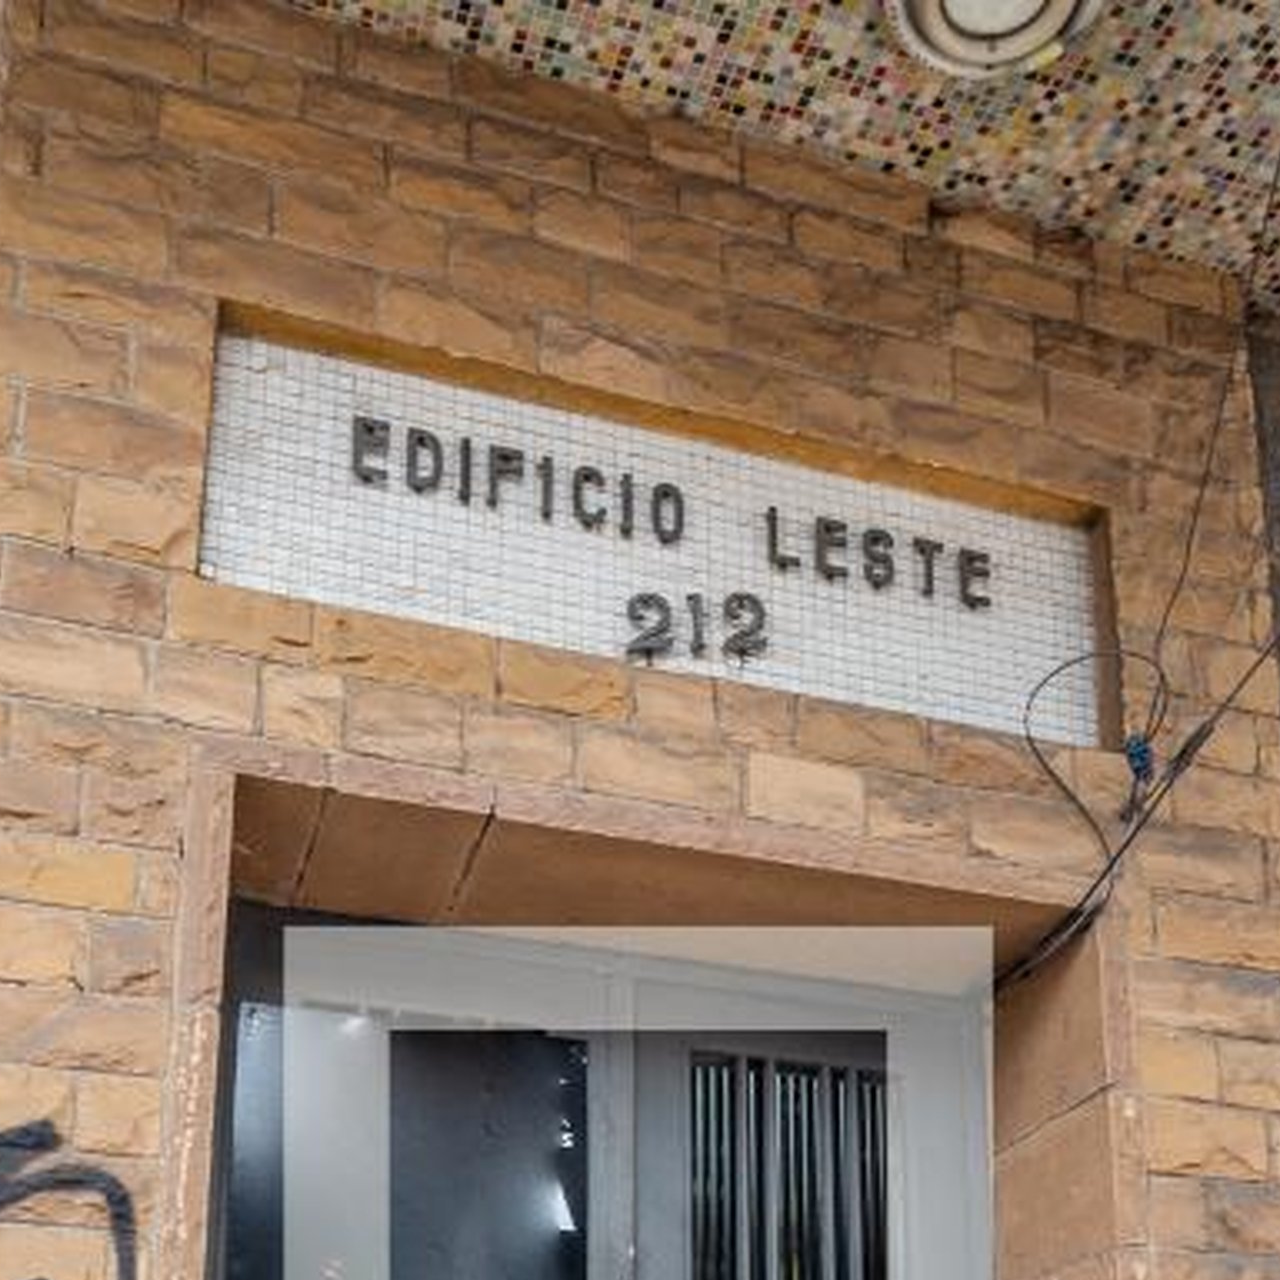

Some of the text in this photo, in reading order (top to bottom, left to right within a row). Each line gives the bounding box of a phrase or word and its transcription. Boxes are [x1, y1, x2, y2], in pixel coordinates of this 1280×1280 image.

[352, 414, 992, 610] EDIFICIO LESTE
[626, 592, 769, 664] 212
